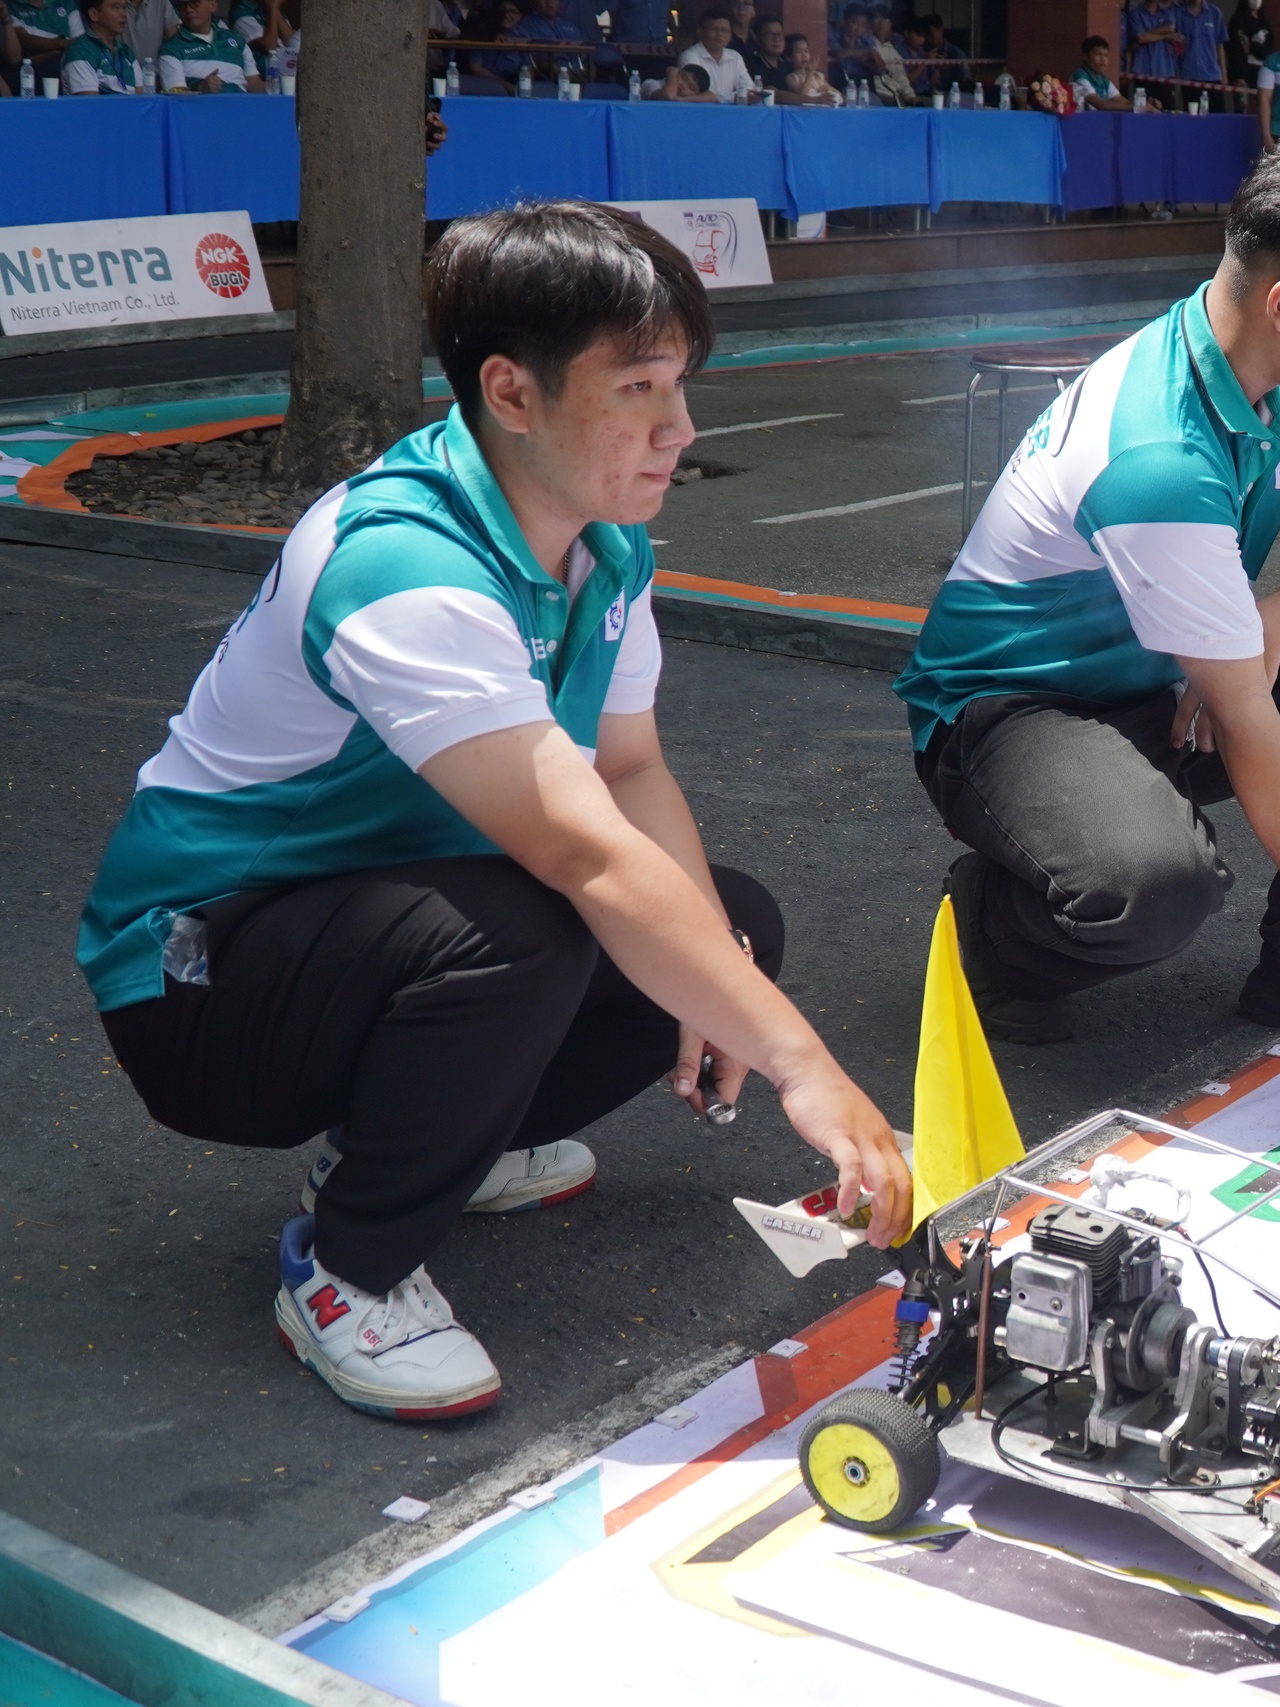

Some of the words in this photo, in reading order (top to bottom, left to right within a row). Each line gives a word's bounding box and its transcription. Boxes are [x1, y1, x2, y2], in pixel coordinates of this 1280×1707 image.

[200, 246, 239, 265] NGK
[0, 246, 173, 296] Niterra
[209, 272, 244, 287] BUGI
[10, 305, 61, 322] Niterra
[62, 301, 123, 316] Vietnam
[154, 292, 180, 308] Ltd.
[761, 1215, 823, 1239] CASTER
